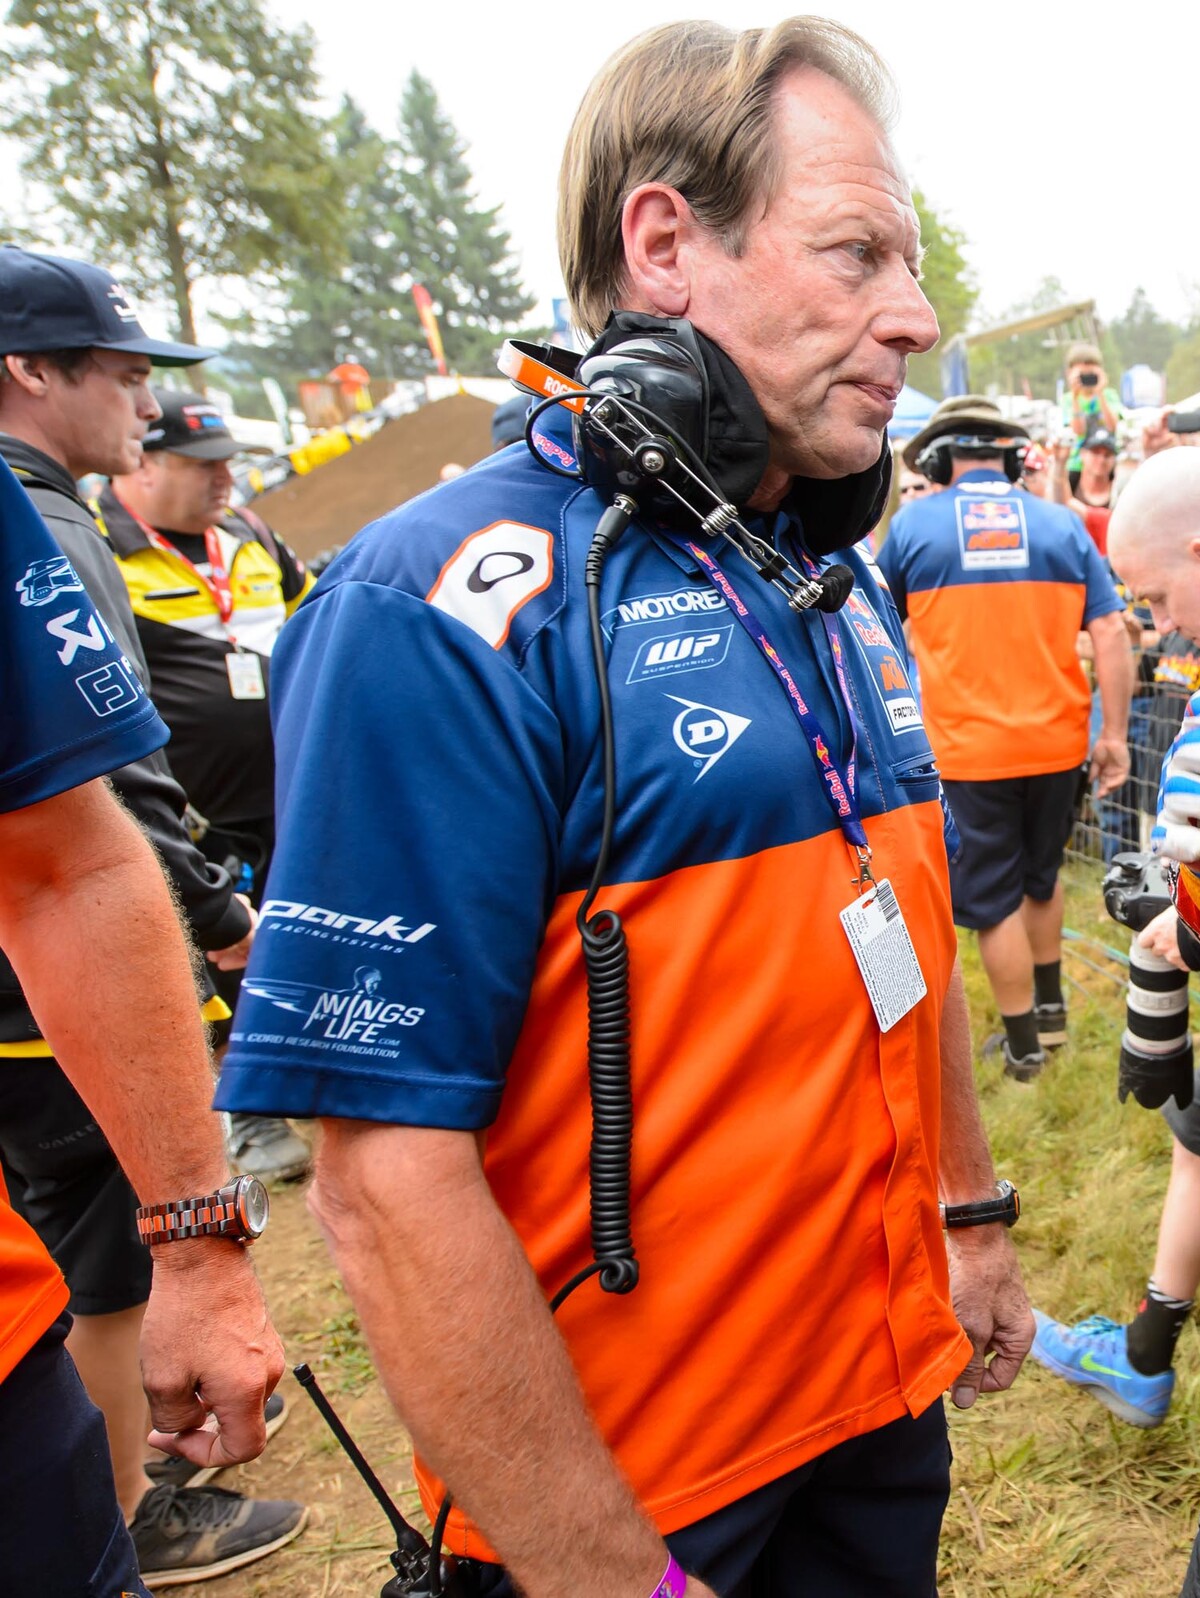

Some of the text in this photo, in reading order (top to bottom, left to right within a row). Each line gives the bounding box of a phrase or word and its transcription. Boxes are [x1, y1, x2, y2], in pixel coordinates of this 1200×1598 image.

[644, 633, 721, 666] WP
[267, 922, 405, 954] RACING SYSTEMS
[324, 1016, 387, 1044] LIFE
[331, 1041, 400, 1059] FOUNDATION
